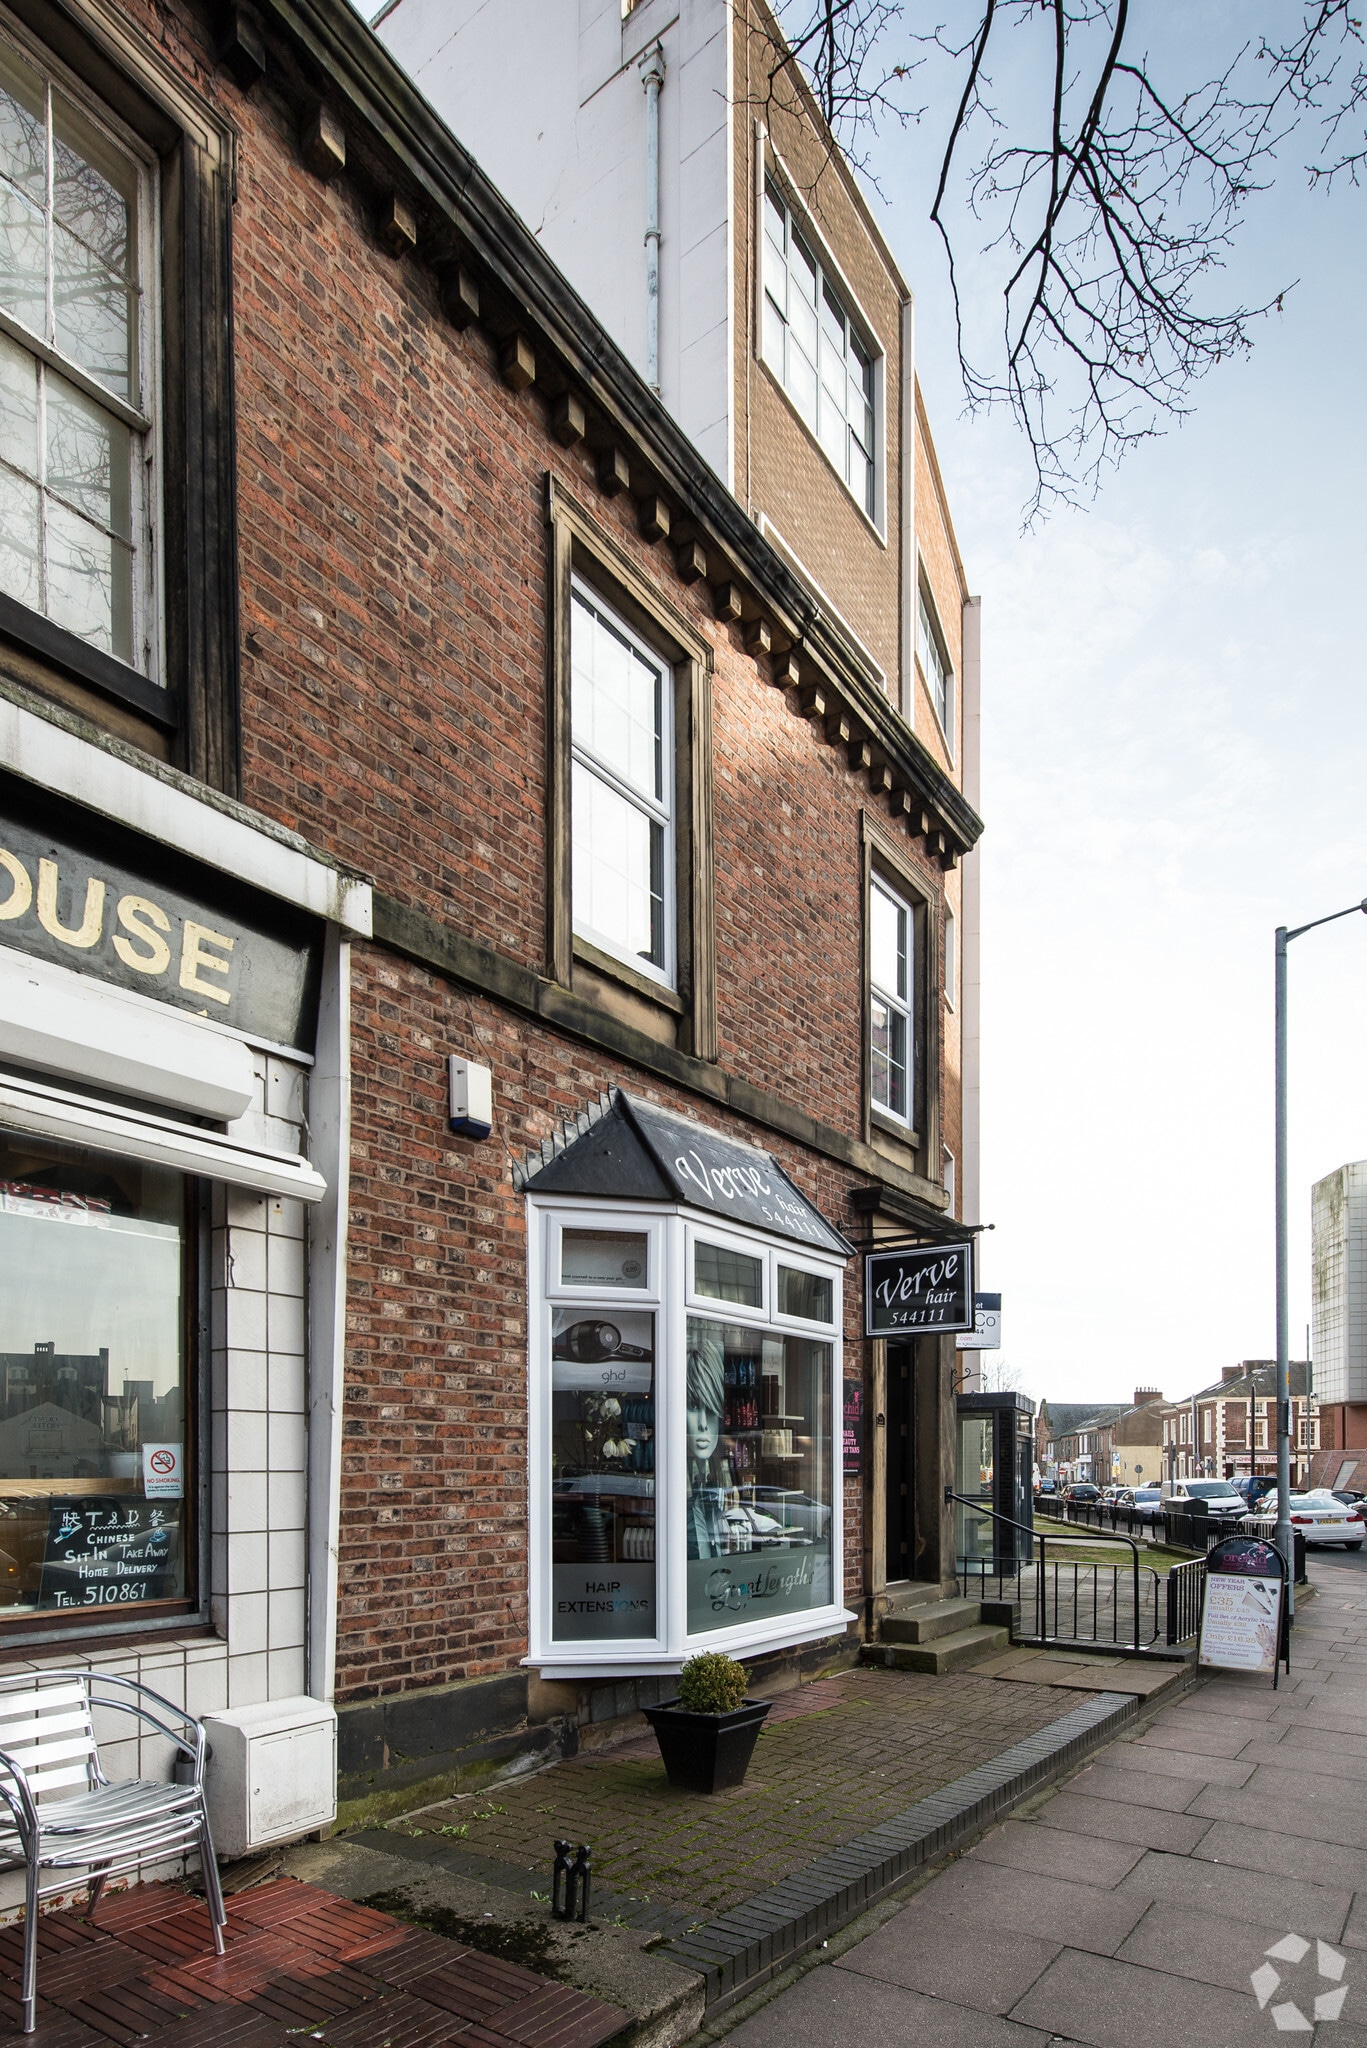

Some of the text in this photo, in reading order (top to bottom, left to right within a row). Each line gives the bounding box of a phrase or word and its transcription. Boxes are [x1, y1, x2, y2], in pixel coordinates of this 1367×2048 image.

[675, 1150, 771, 1200] Verve
[775, 1194, 807, 1218] hair
[761, 1206, 824, 1239] 544111
[875, 1254, 958, 1308] Verve
[925, 1288, 957, 1304] hair
[890, 1308, 945, 1325] 544111
[601, 1369, 626, 1384] ghd
[843, 1401, 860, 1414] chid
[85, 1511, 103, 1526] T
[125, 1509, 139, 1525] D
[87, 1533, 135, 1545] CHINESE
[119, 1544, 144, 1559] TAKE
[144, 1542, 169, 1558] AWAY
[1223, 1553, 1267, 1564] orchid
[116, 1561, 158, 1576] DELIVERY
[585, 1581, 621, 1593] HAIR
[1210, 1582, 1245, 1591] OFFERS
[54, 1590, 81, 1607] TEL.
[1209, 1596, 1234, 1606] £35
[557, 1600, 649, 1613] EXTENSIONS
[1206, 1632, 1225, 1641] Only
